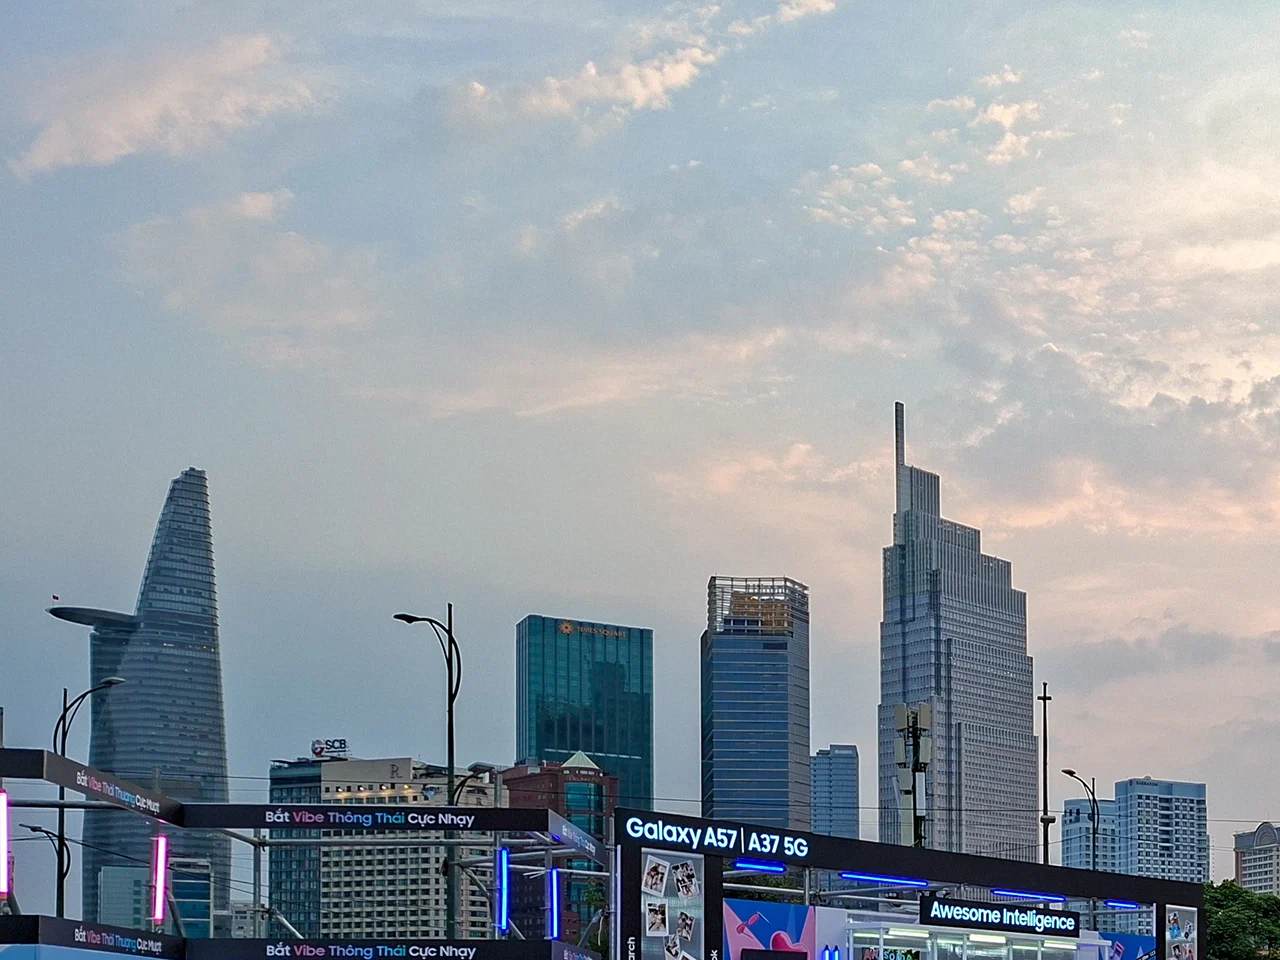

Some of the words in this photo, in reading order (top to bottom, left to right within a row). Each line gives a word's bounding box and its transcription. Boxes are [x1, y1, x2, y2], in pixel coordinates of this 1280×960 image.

[577, 626, 597, 634] TIMES
[598, 629, 627, 637] SQUARE
[325, 739, 346, 750] SCB
[265, 808, 290, 823] Bắt
[293, 811, 324, 823] Vibe
[327, 810, 372, 827] Thông
[375, 811, 405, 824] Thái
[408, 812, 436, 827] Cực
[438, 812, 475, 828] Nhạy
[626, 817, 702, 850] Galaxy
[704, 826, 738, 850] A57
[748, 832, 780, 854] A37
[784, 837, 809, 857] 5G
[930, 901, 1001, 923] Awesome
[1002, 908, 1075, 932] Intelligence
[86, 930, 101, 944] Vibe
[266, 942, 291, 957] Bắt
[294, 945, 326, 957] Vibe
[328, 945, 373, 960] Thông
[376, 944, 406, 957] Thái
[408, 945, 437, 960] Cực
[439, 945, 476, 960] Nhạy
